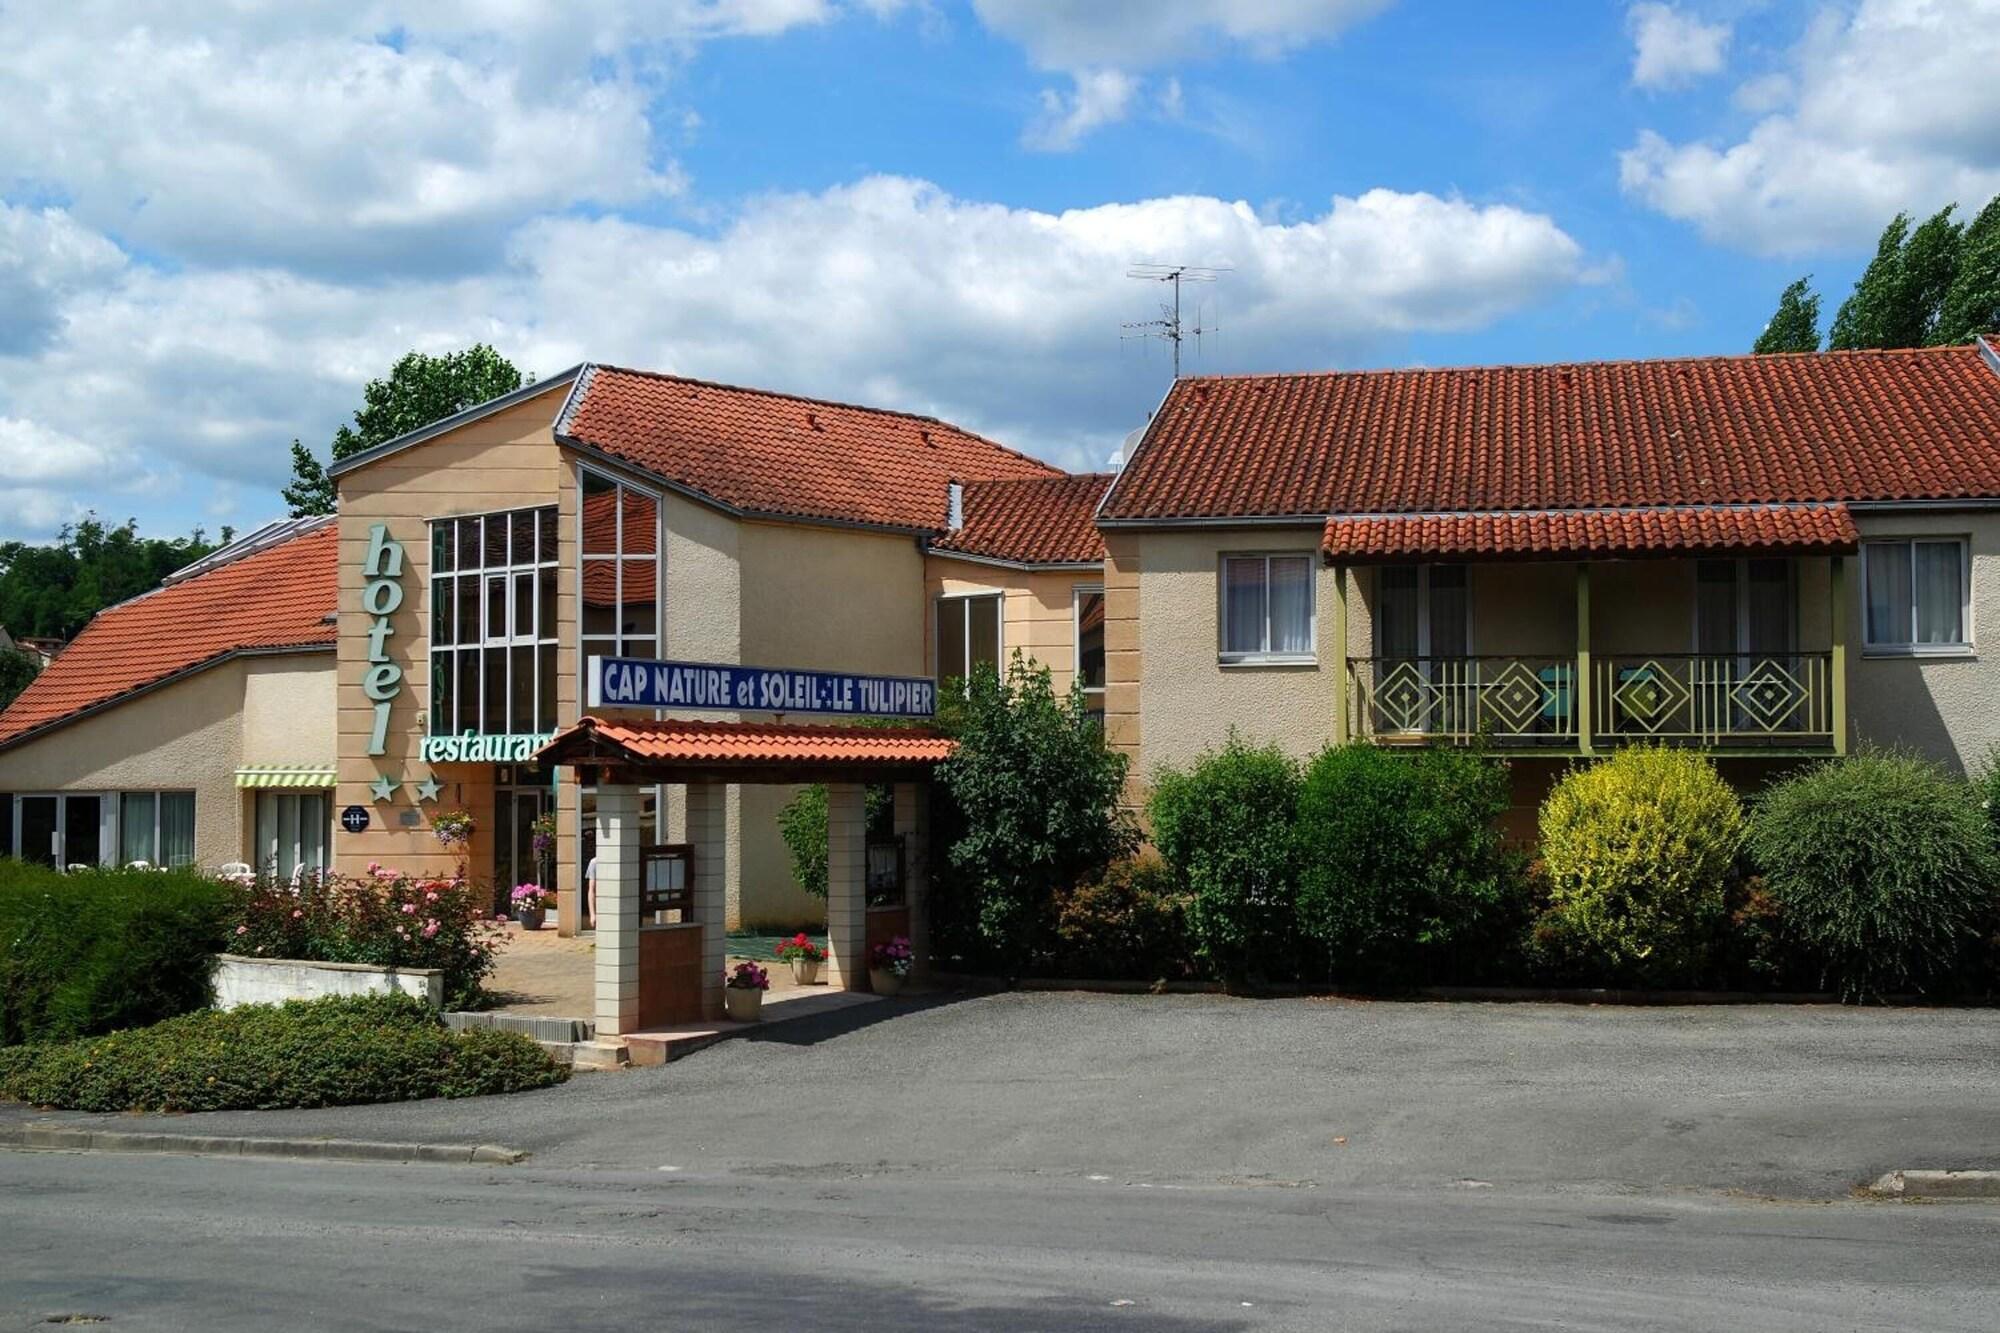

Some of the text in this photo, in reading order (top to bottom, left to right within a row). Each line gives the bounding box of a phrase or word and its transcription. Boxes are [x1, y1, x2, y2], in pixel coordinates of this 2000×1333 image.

[362, 524, 404, 757] hotel
[604, 662, 933, 715] CAP NATURE et SOLEIL LE TULIPIER
